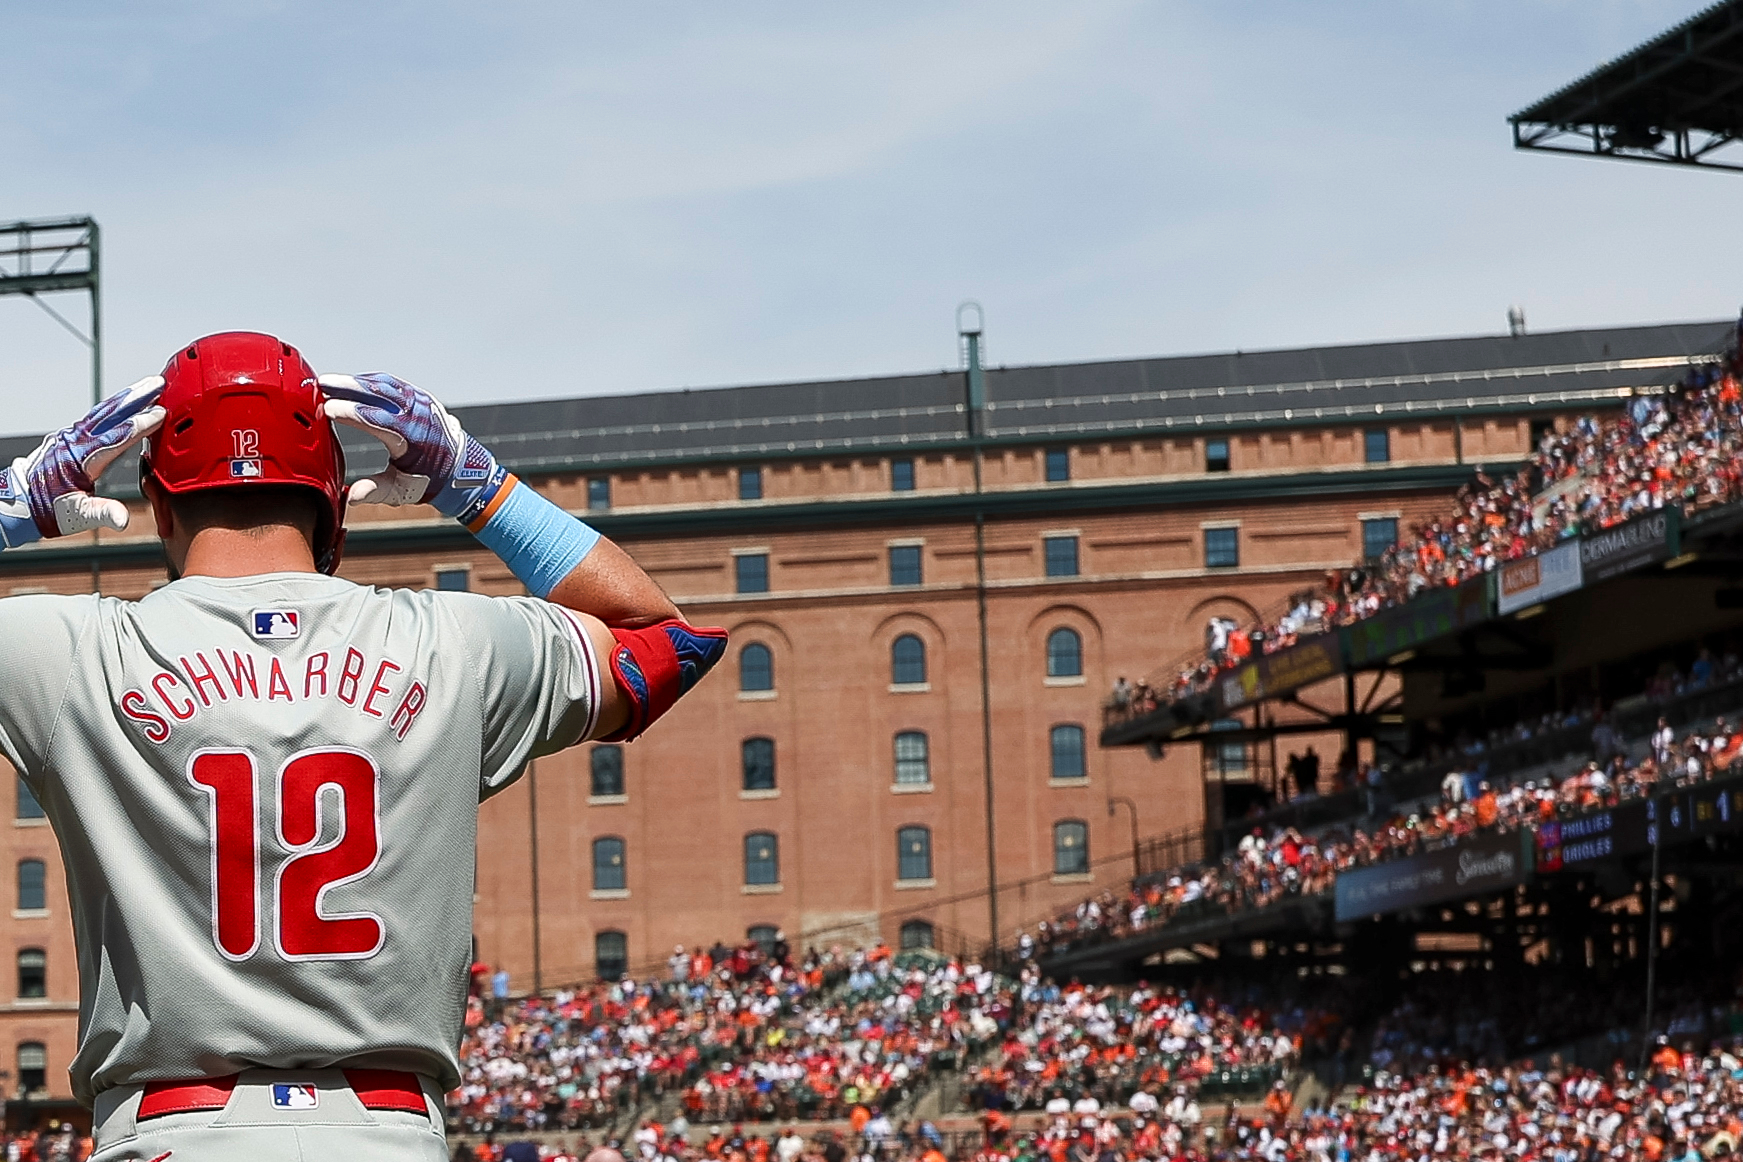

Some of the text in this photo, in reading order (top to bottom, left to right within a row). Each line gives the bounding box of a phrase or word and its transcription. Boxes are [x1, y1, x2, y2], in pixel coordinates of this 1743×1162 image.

[231, 429, 259, 458] 12
[118, 643, 429, 745] SCHWARBER
[1560, 813, 1613, 841] PHILLIES
[187, 745, 386, 962] 12
[1563, 836, 1613, 864] ORIOLES
